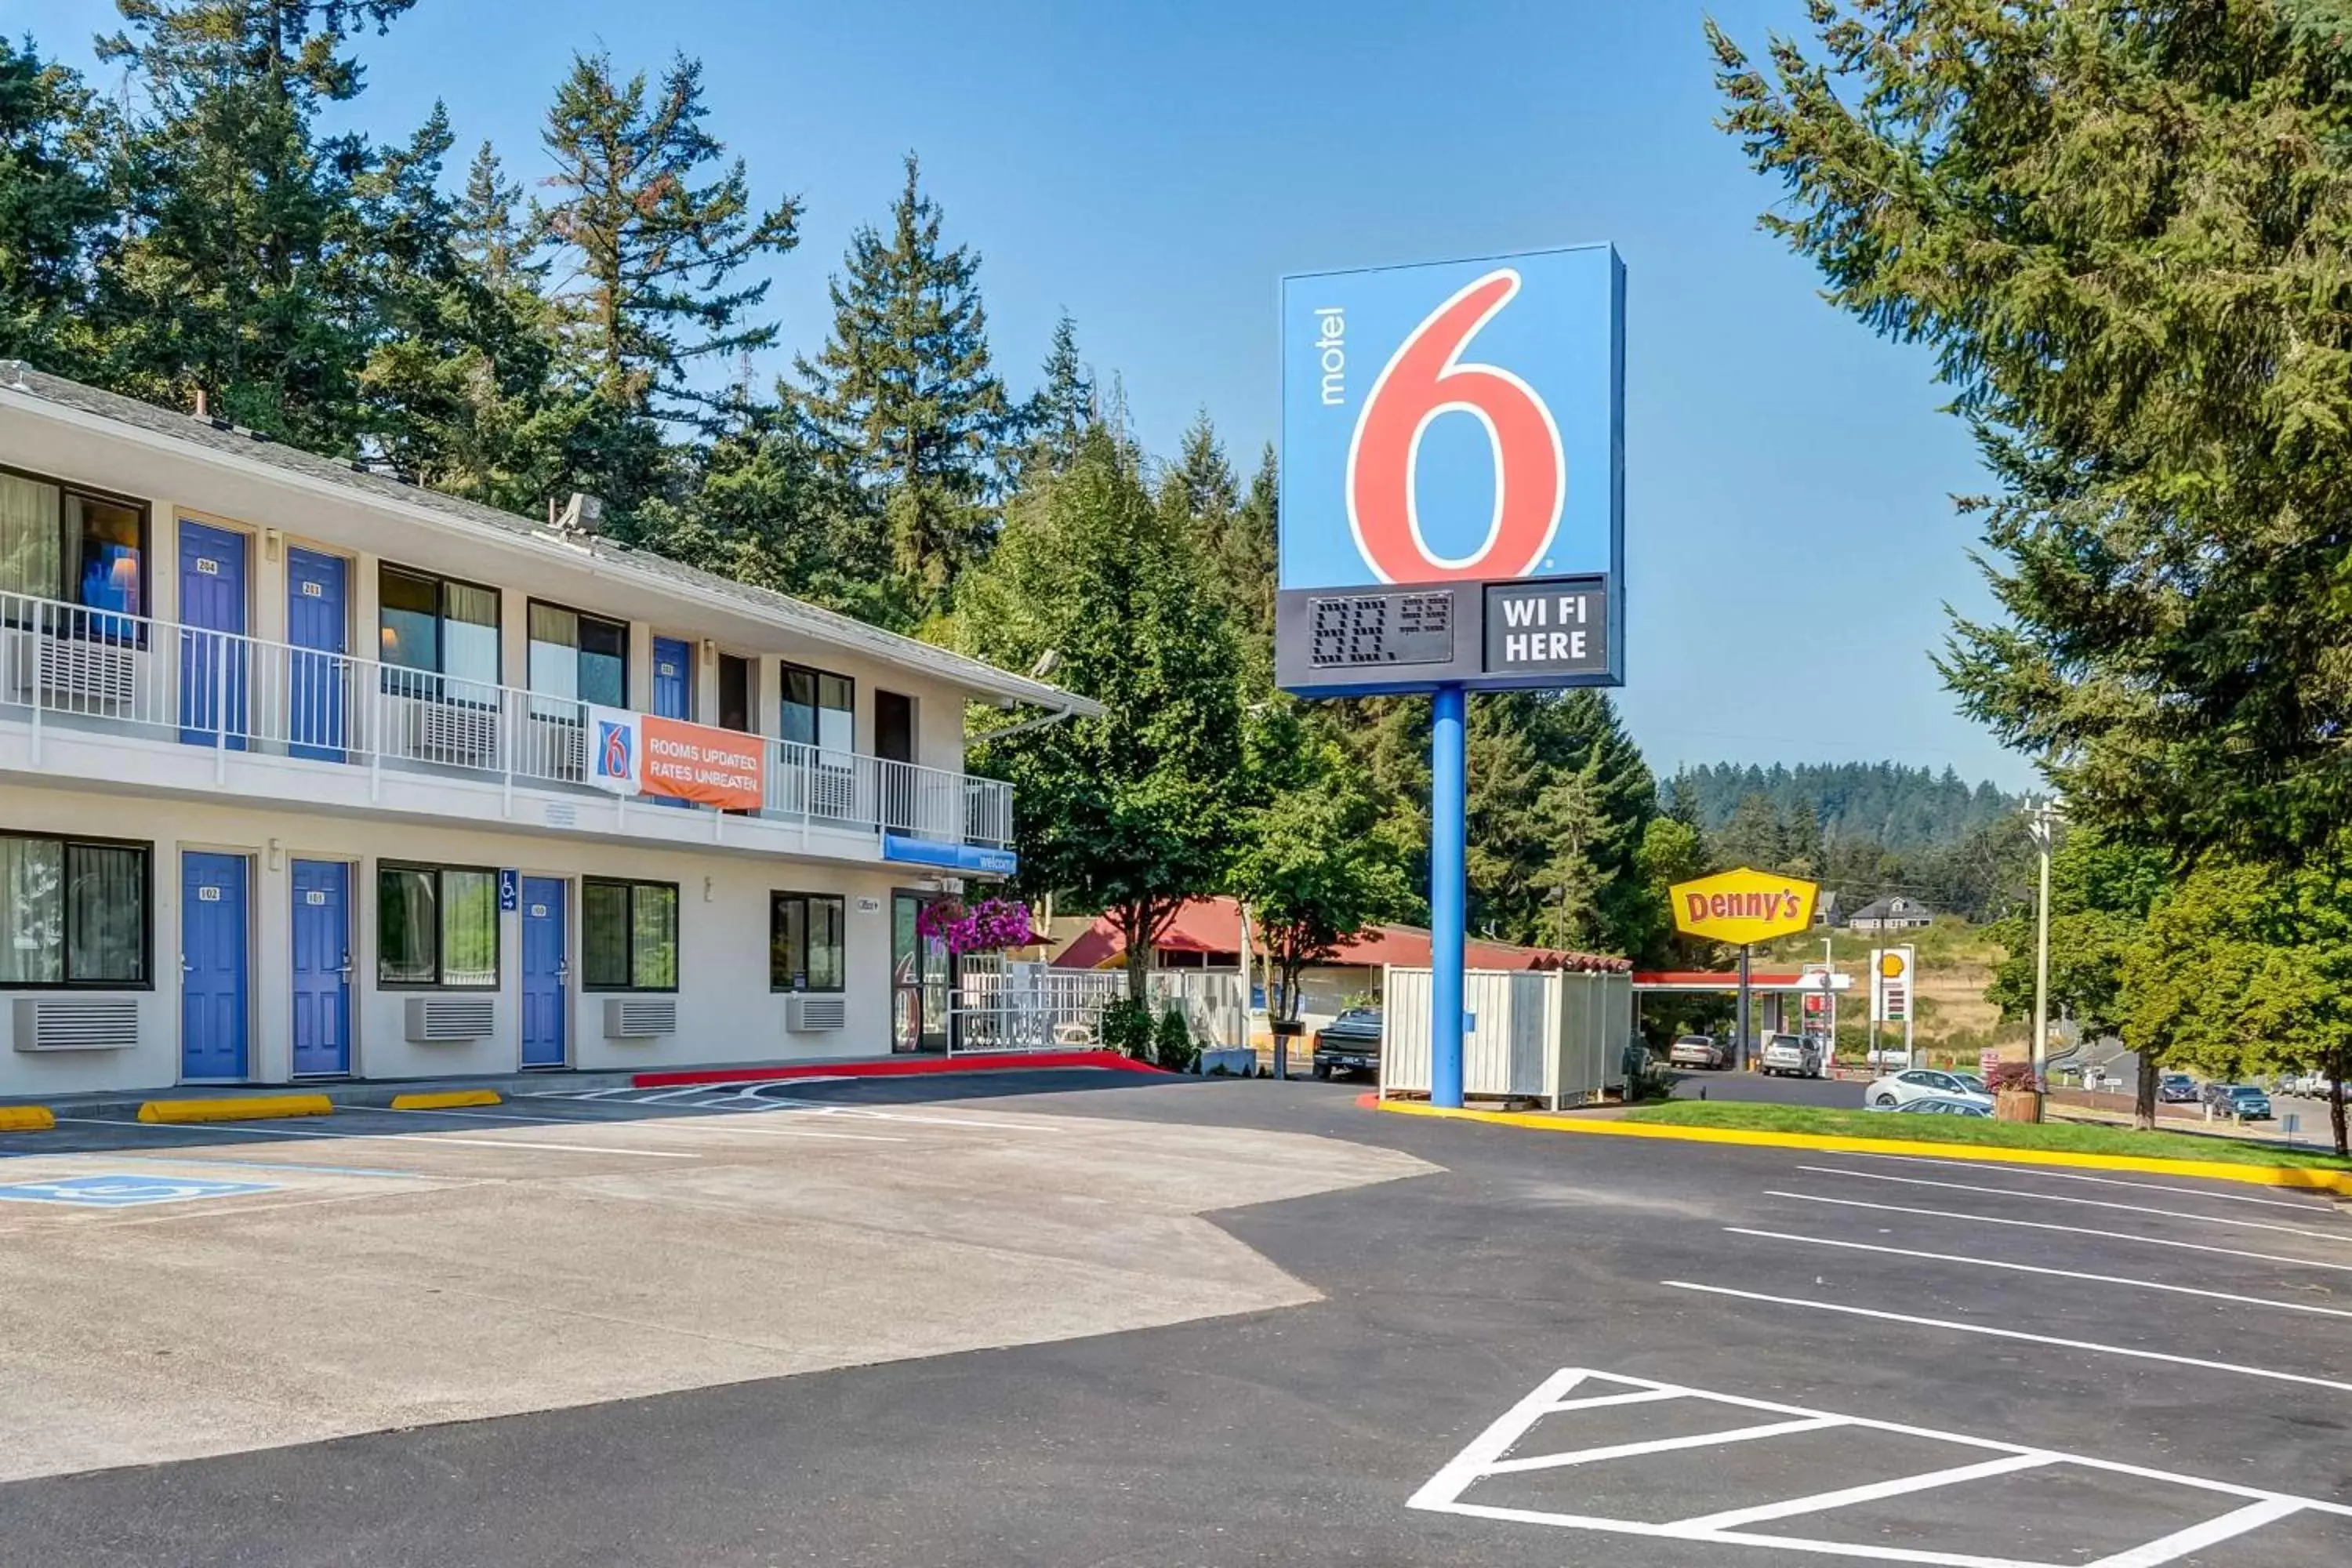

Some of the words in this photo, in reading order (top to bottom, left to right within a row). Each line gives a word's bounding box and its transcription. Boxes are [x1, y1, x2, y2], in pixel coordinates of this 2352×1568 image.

[1314, 308, 1345, 405] motel
[1346, 267, 1566, 585] 6
[1502, 598, 1546, 627] WI
[1559, 596, 1586, 625] FI
[1506, 631, 1586, 662] HERE
[605, 725, 627, 779] 6
[650, 738, 699, 761] ROOMS
[650, 760, 692, 782] RATES
[1686, 887, 1801, 923] Denny's
